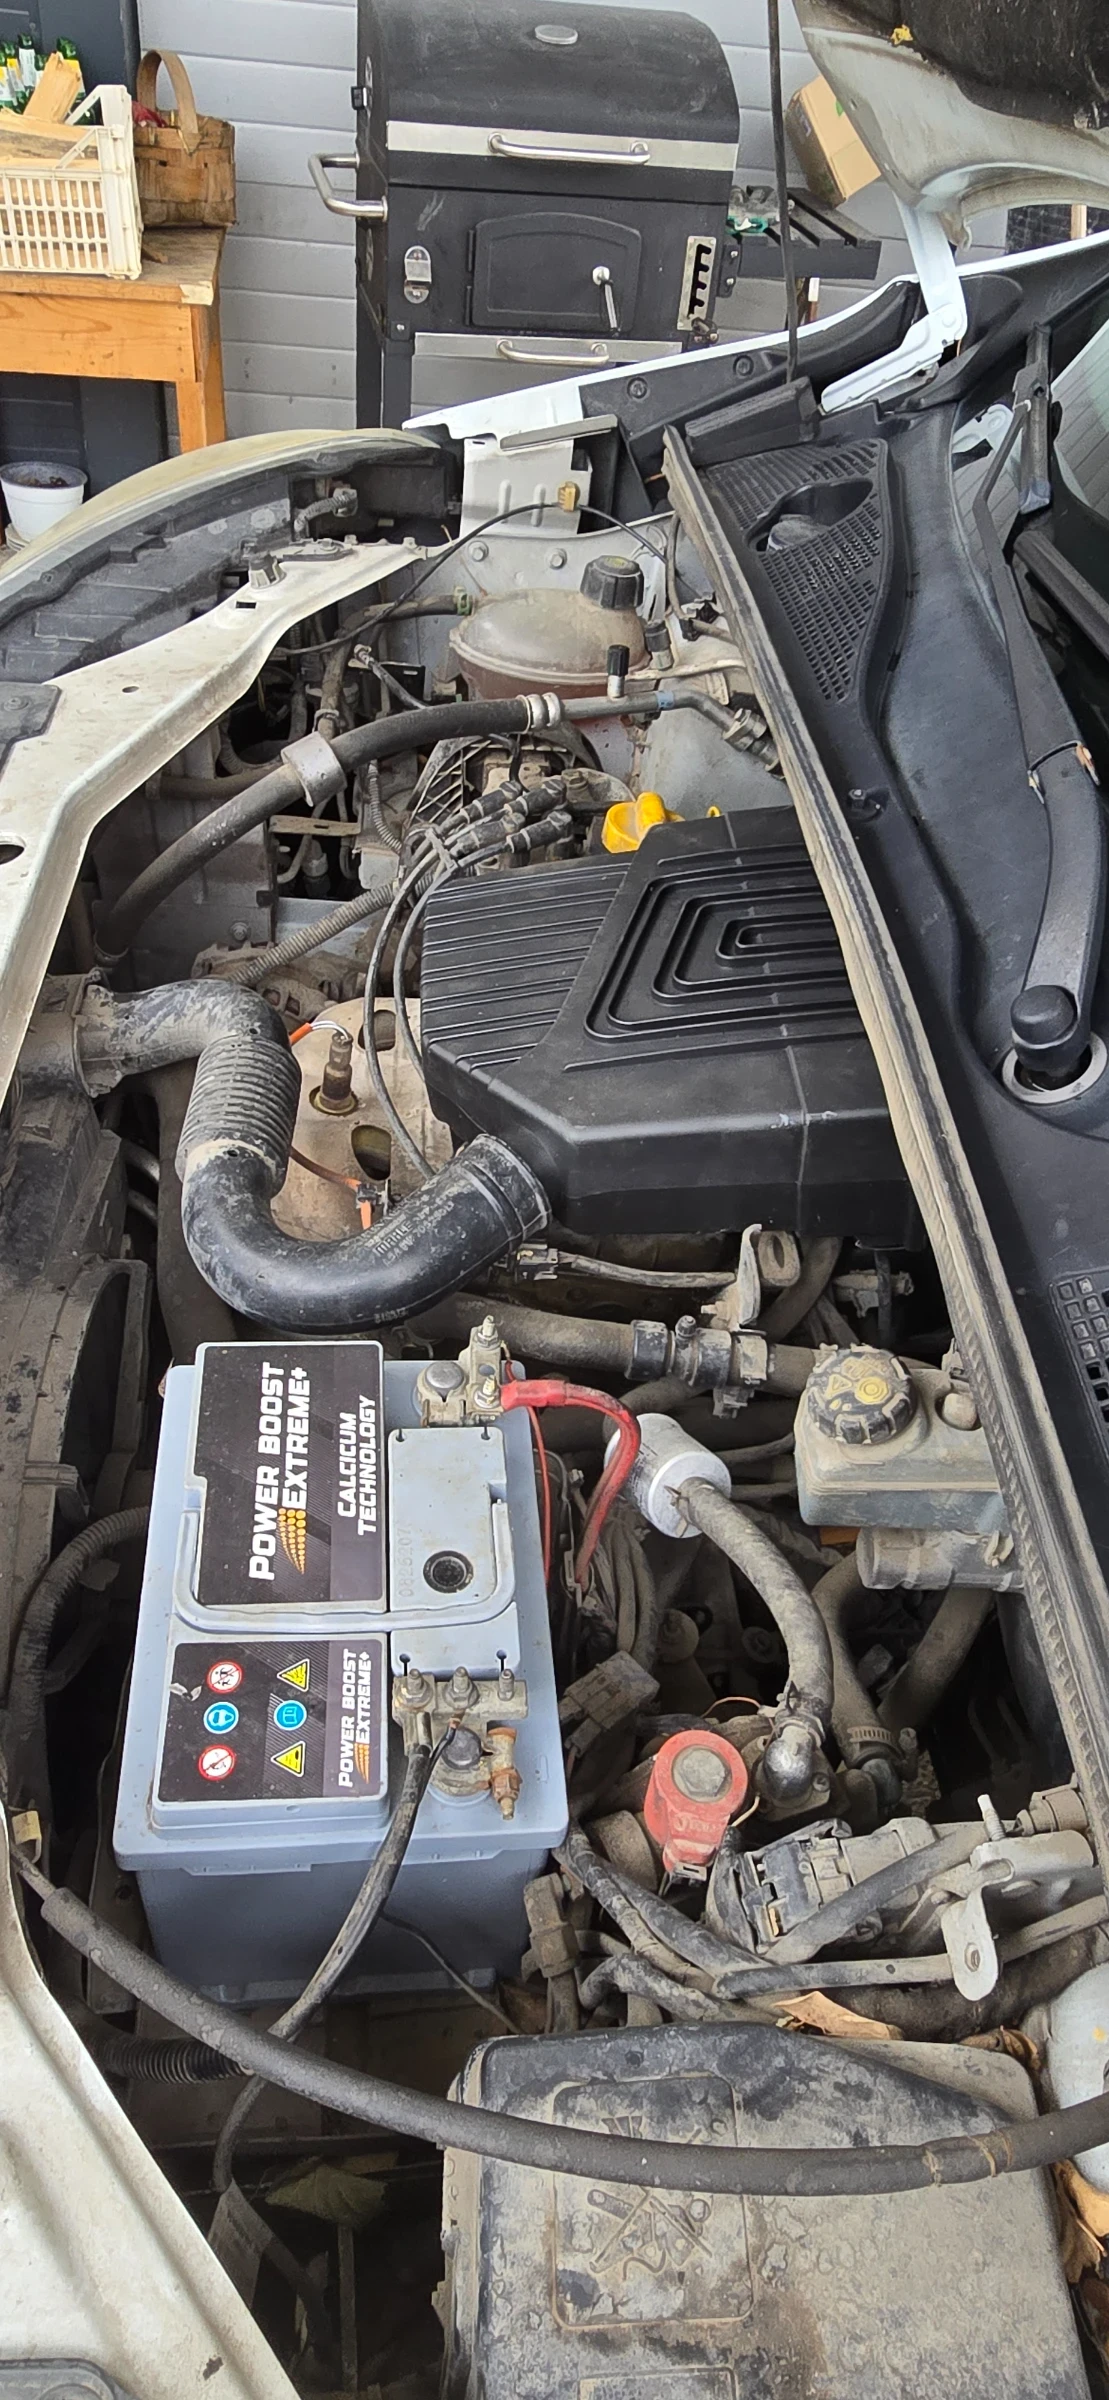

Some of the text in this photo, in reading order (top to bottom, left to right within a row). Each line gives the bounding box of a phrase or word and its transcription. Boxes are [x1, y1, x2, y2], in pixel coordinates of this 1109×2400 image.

[248, 1361, 285, 1581] POWER BOOST
[282, 1366, 310, 1510] EXTREME+
[338, 1412, 357, 1518] CALCICUM
[358, 1395, 376, 1535] TECHNOLOGY
[338, 1648, 357, 1788] POWER BOOST
[355, 1651, 372, 1744] EXTREME+
